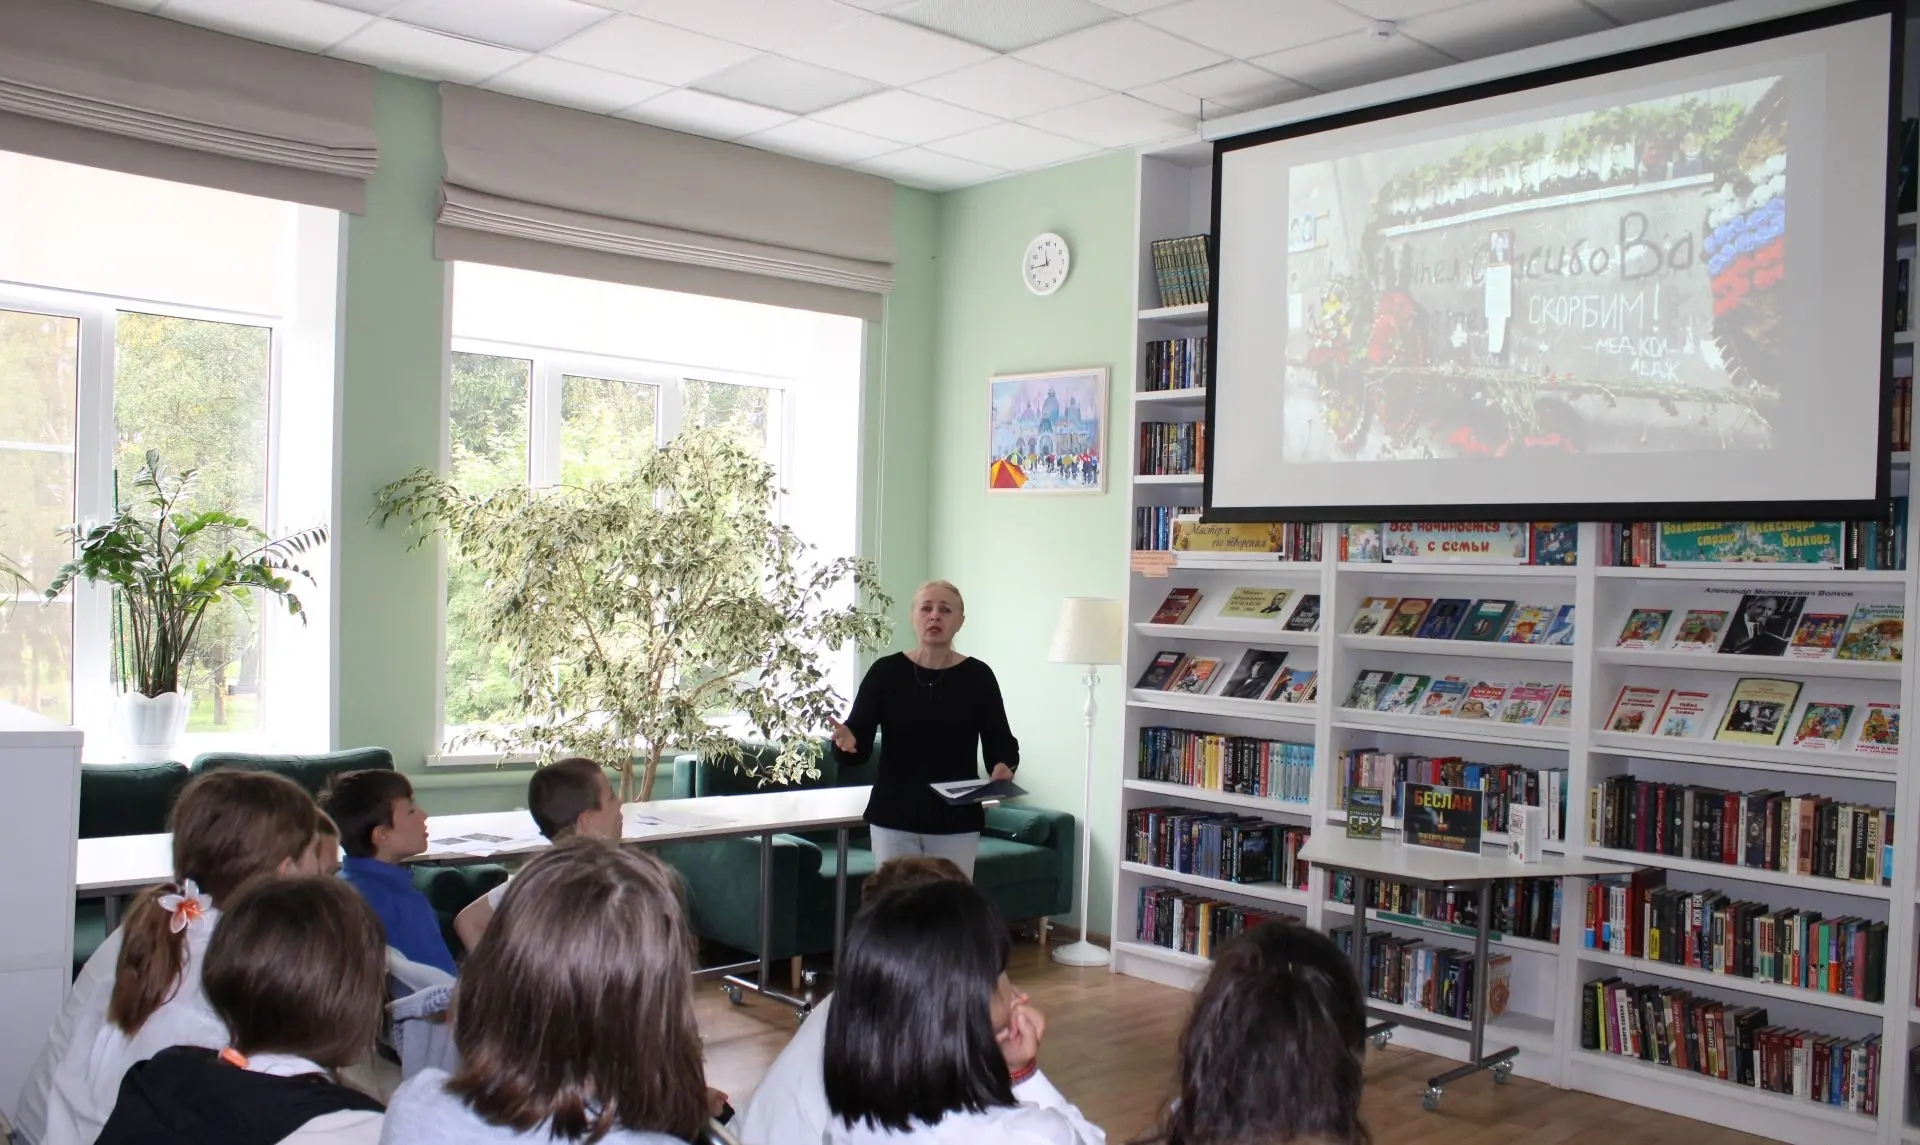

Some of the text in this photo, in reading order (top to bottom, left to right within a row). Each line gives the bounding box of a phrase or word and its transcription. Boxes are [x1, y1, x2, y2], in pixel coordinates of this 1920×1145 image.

[1442, 541, 1490, 553] семьи
[1697, 532, 1737, 547] страна
[1781, 531, 1831, 548] Волкова
[1414, 790, 1473, 811] БЕСЛАН
[1349, 815, 1380, 826] ГРУ
